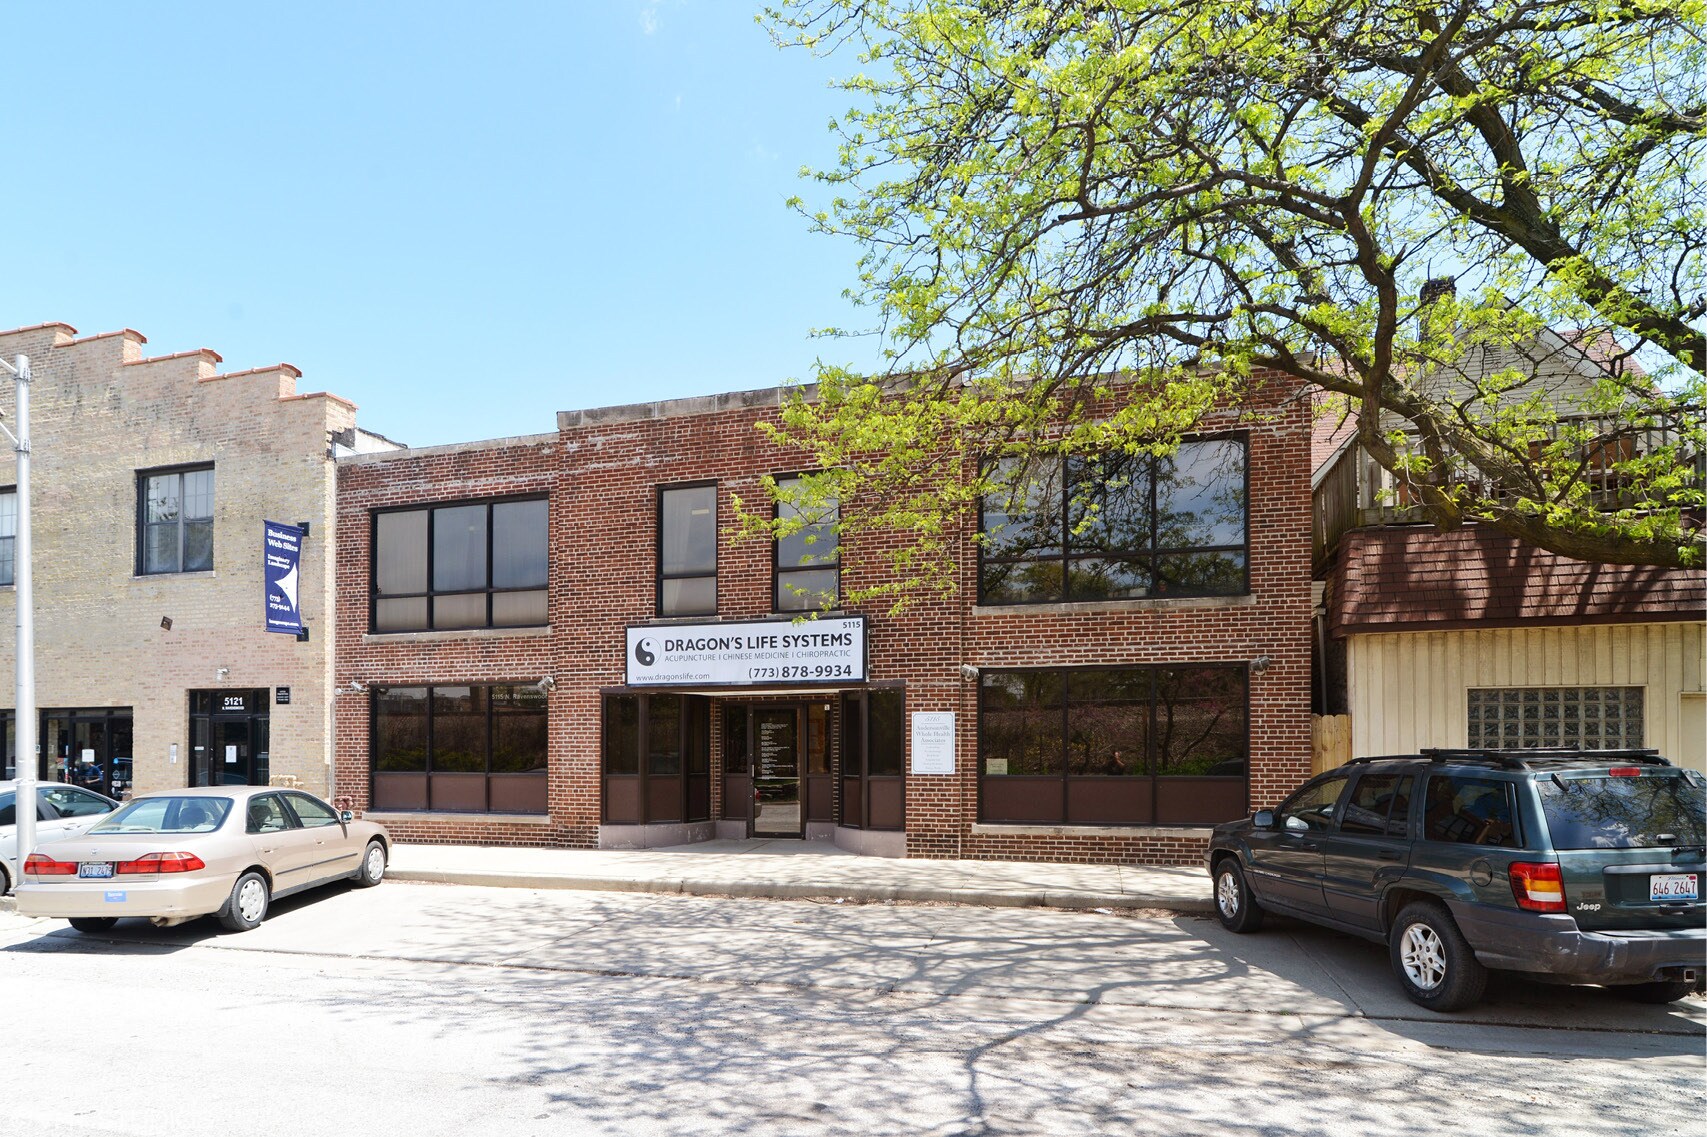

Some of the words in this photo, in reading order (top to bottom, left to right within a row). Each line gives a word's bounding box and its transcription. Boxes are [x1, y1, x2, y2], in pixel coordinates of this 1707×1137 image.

[267, 528, 297, 543] Business
[267, 537, 283, 549] Web
[282, 542, 299, 553] Sites
[842, 621, 861, 629] 5115
[664, 637, 743, 652] DRAGON'S
[747, 635, 778, 649] LIFE
[782, 633, 852, 648] SYSTEMS
[664, 654, 716, 662] ACUPUNCTURE
[722, 652, 753, 660] CHINESE
[754, 651, 789, 659] MEDICINE
[796, 649, 851, 658] CHIROPRACTIC
[635, 672, 710, 682] www.dragonslife.com
[748, 667, 779, 679] (773)
[781, 664, 852, 678] 878-9934
[224, 697, 243, 706] 5121
[1652, 881, 1670, 896] 646
[1674, 881, 1696, 895] 2647
[1576, 902, 1602, 912] Jeep
